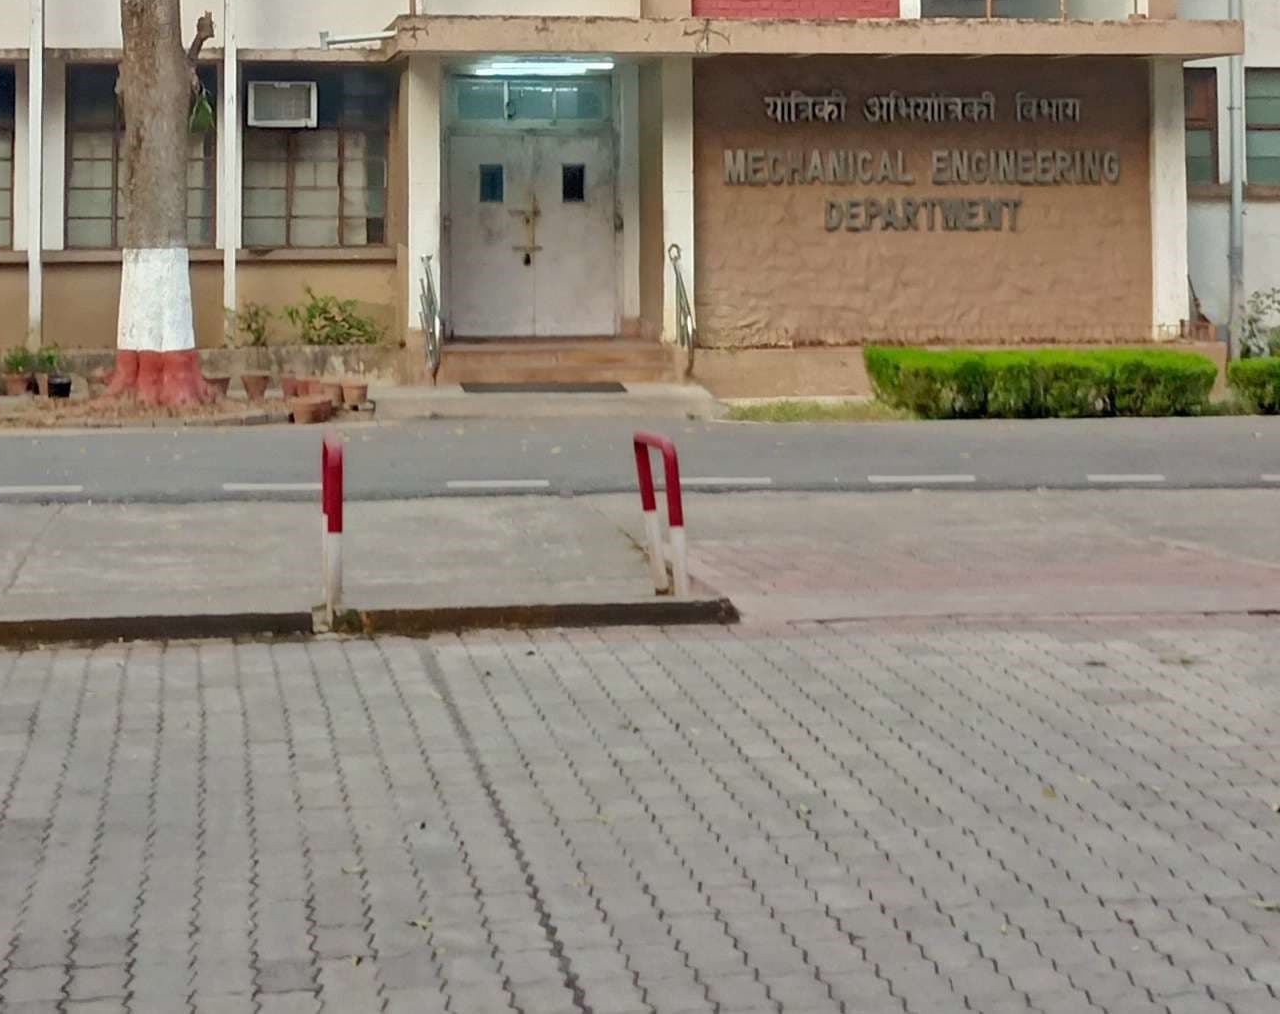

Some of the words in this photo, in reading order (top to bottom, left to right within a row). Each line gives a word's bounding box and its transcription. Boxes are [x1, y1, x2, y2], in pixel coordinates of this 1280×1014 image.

[763, 89, 847, 123] यांत्रिकी
[863, 89, 996, 123] अभियांत्रिकी
[1015, 90, 1081, 123] विभाग
[723, 147, 915, 186] MECHANICAL
[930, 147, 1120, 186] ENGINEERING
[824, 196, 1023, 232] DEPARTMENT
